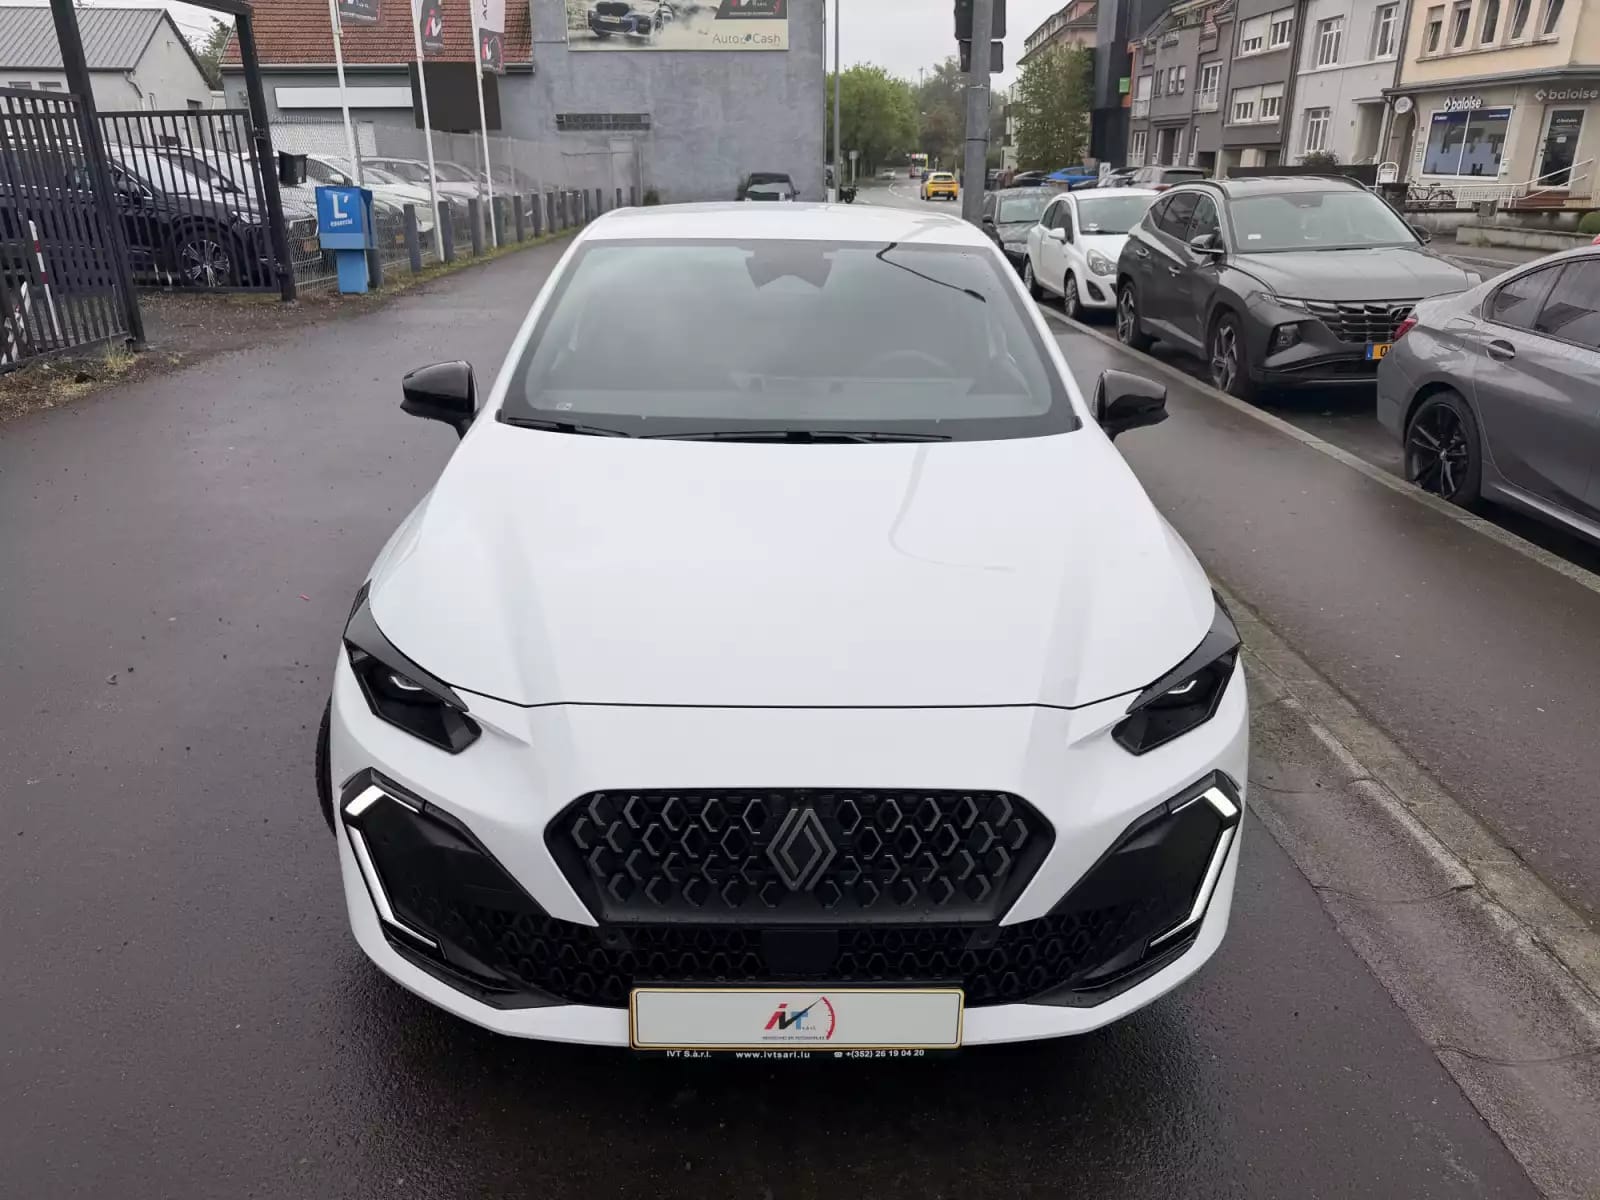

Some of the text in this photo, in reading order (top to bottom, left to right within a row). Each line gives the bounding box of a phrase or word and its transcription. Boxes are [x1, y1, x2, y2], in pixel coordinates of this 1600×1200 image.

[1548, 87, 1599, 100] baloise
[1451, 95, 1482, 110] baloise
[666, 1050, 682, 1058] IVT
[735, 1050, 811, 1059] www.ivtsarl.lu
[845, 1049, 925, 1059] +(352) 26 19 04 20
